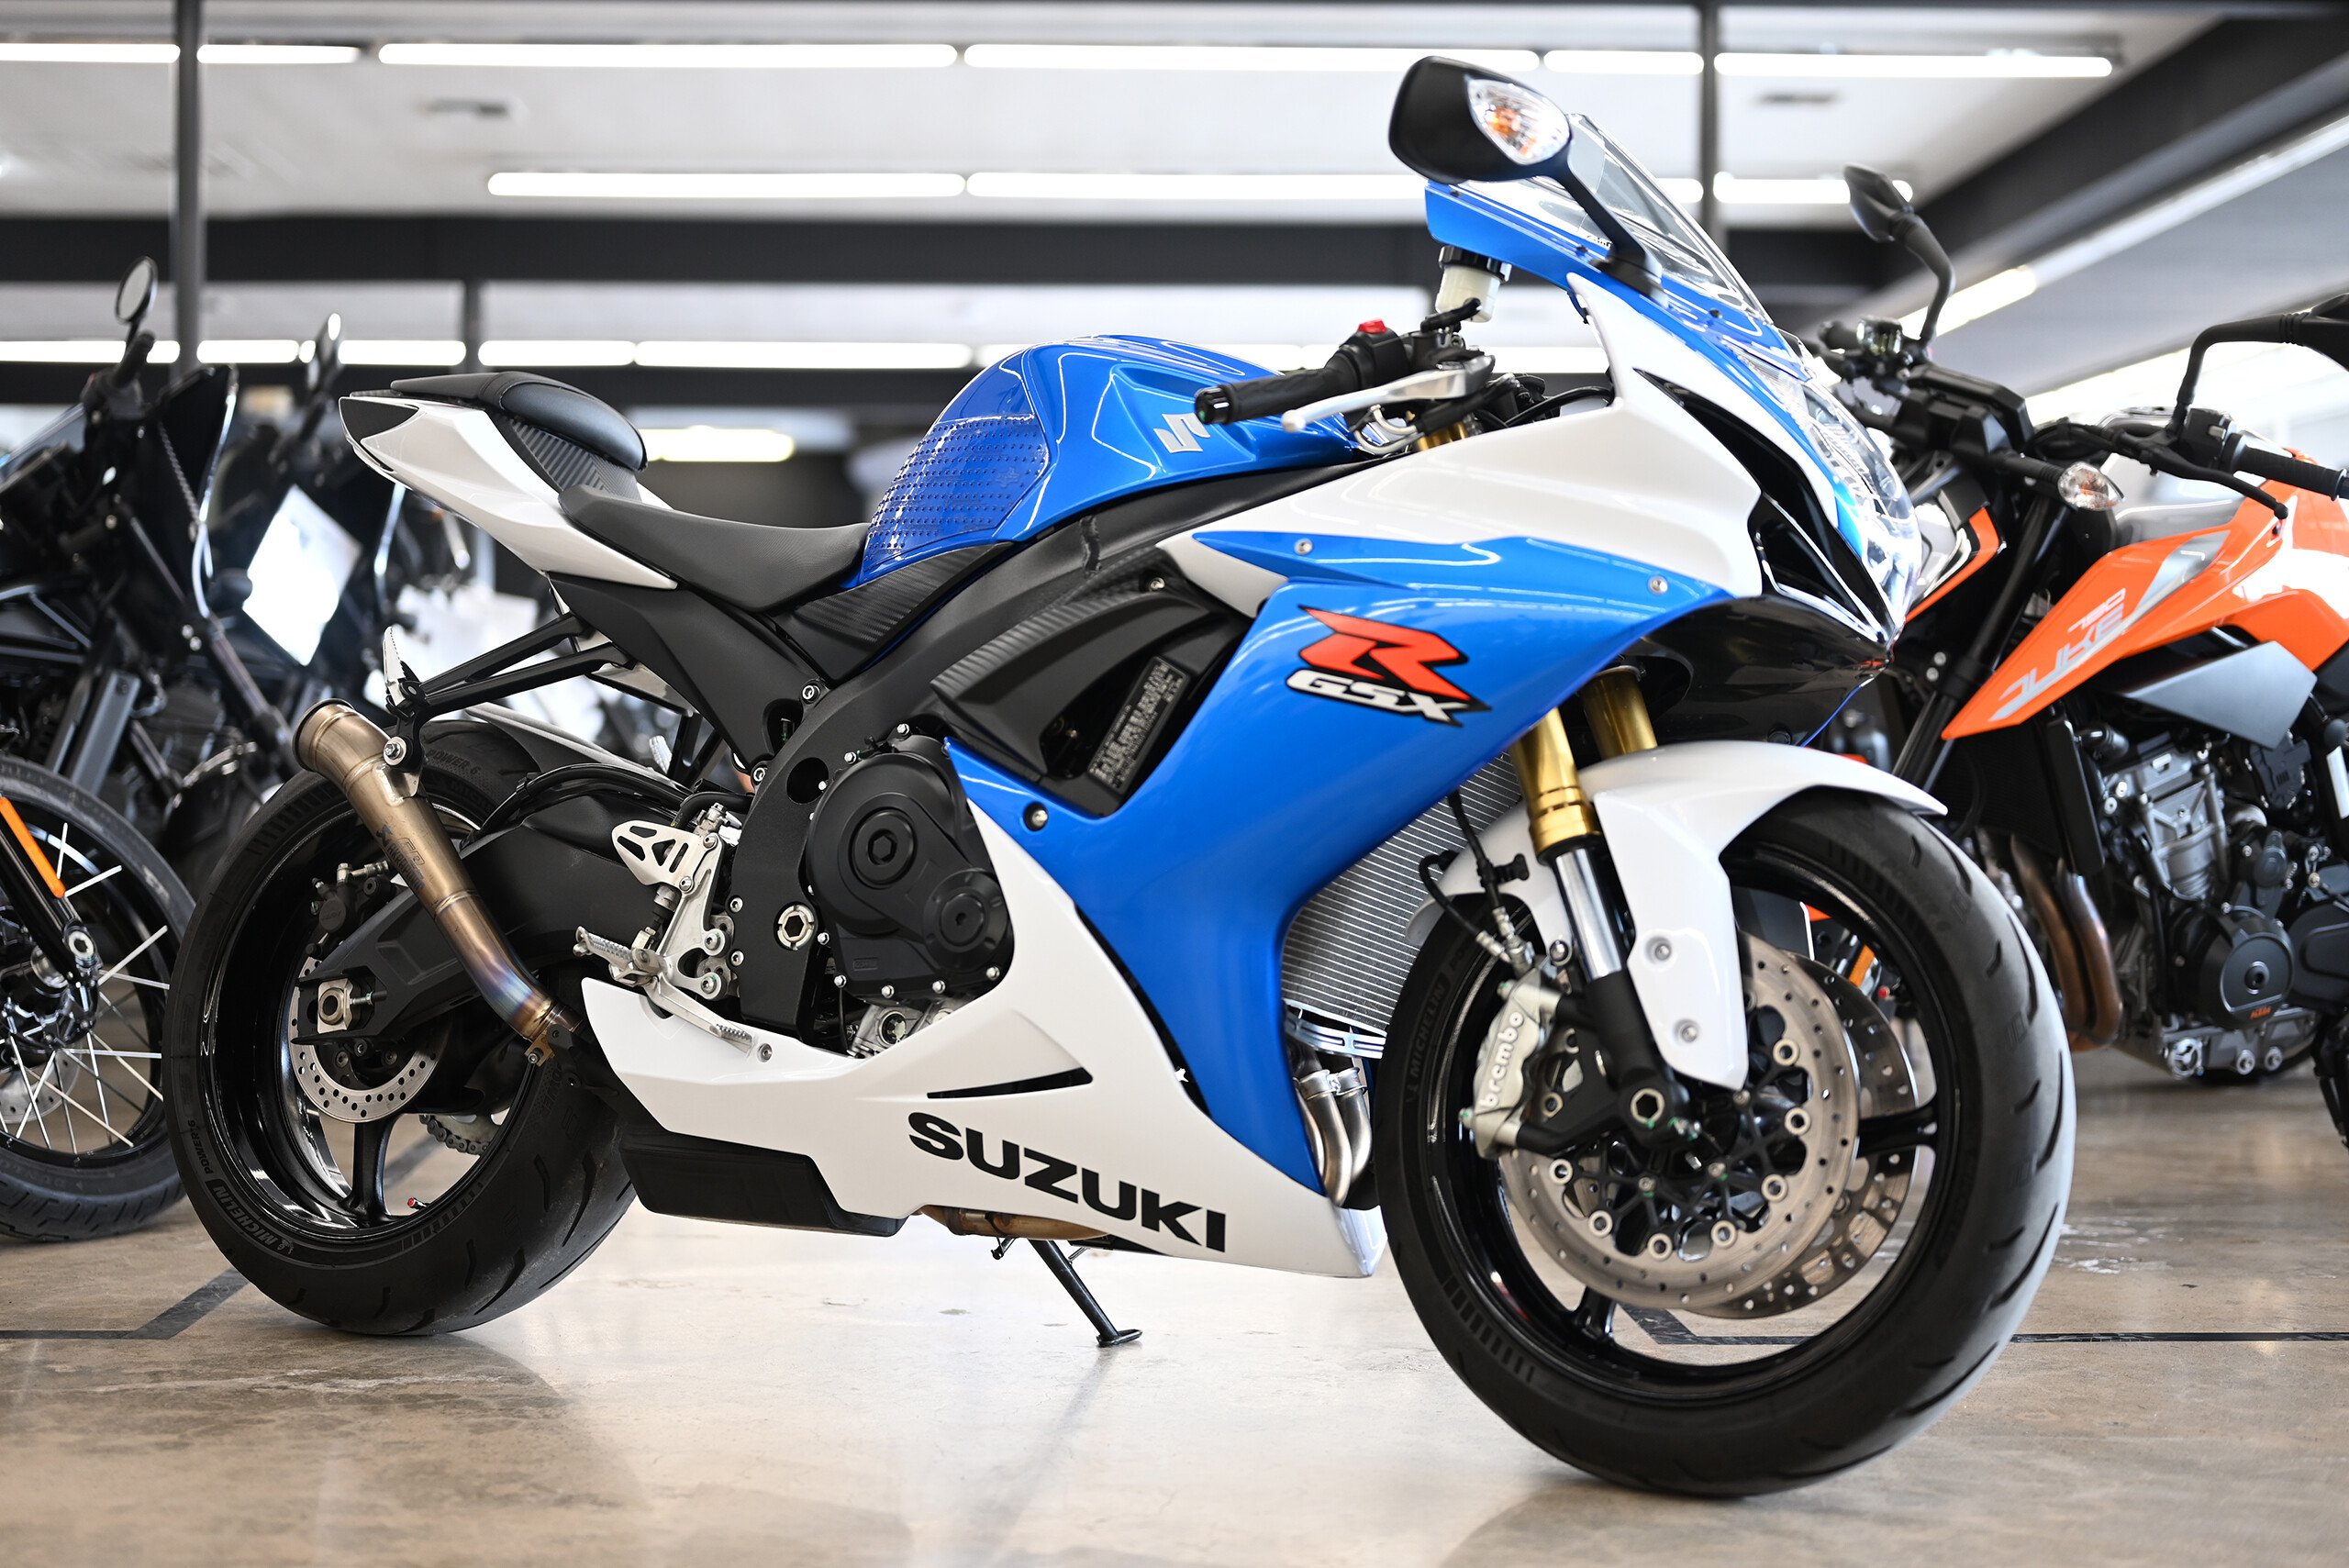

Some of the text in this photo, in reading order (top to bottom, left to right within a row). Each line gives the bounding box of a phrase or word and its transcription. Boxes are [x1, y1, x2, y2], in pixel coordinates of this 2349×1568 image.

[1286, 668, 1470, 724] GSX
[1298, 605, 1474, 703] R
[1987, 602, 2125, 723] DUKE
[1409, 983, 1447, 1079] MICHELIN
[1476, 1011, 1525, 1108] brembo
[189, 1129, 214, 1174] POWER
[907, 1111, 1226, 1253] SUZUKI
[212, 1184, 277, 1246] MICHELIN
